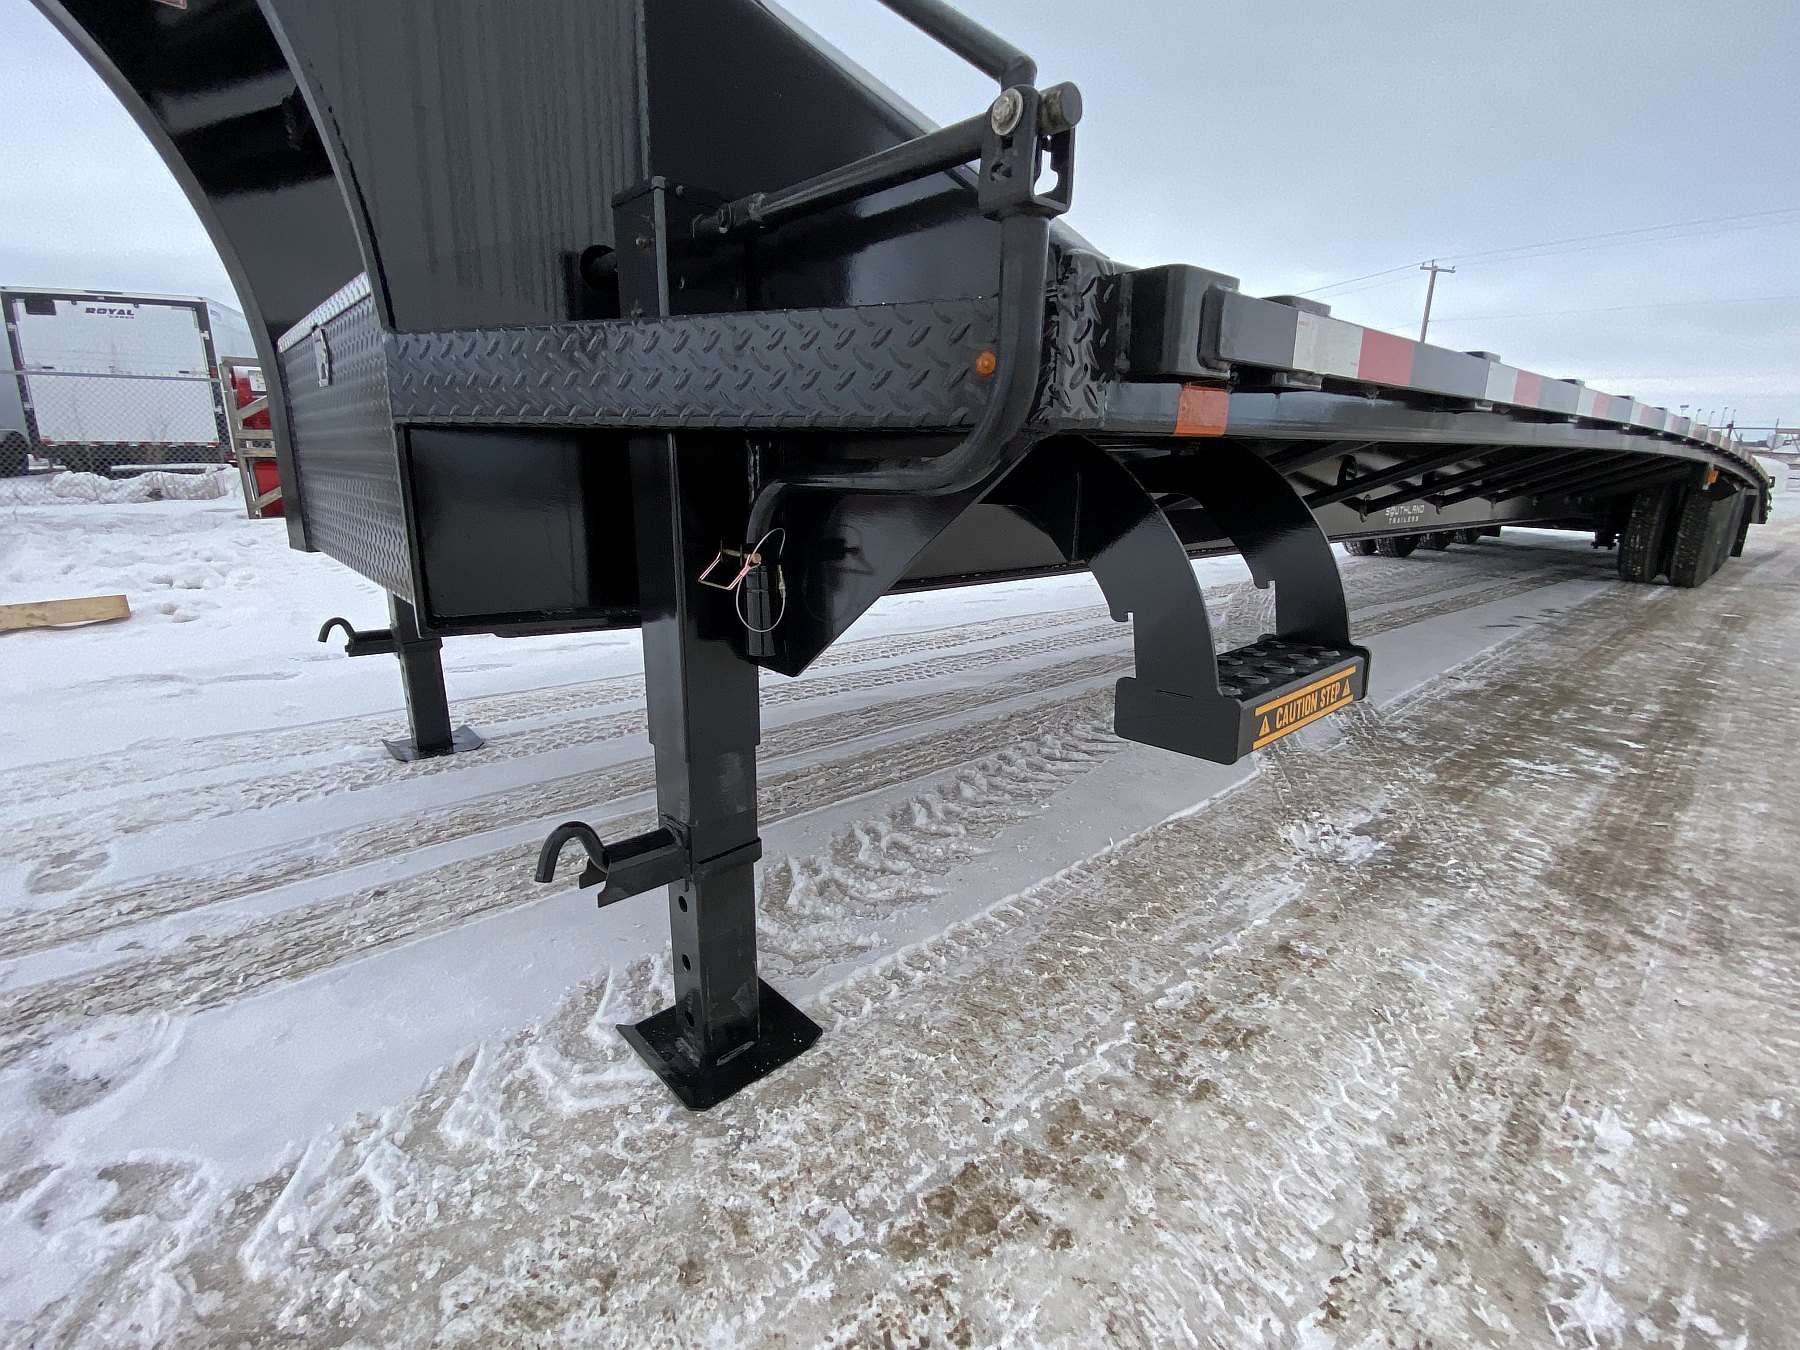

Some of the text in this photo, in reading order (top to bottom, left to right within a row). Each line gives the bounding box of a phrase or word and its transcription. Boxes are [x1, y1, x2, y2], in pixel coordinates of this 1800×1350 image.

[85, 307, 135, 316] ROYAL
[1275, 681, 1341, 729] CAUTION STEP
